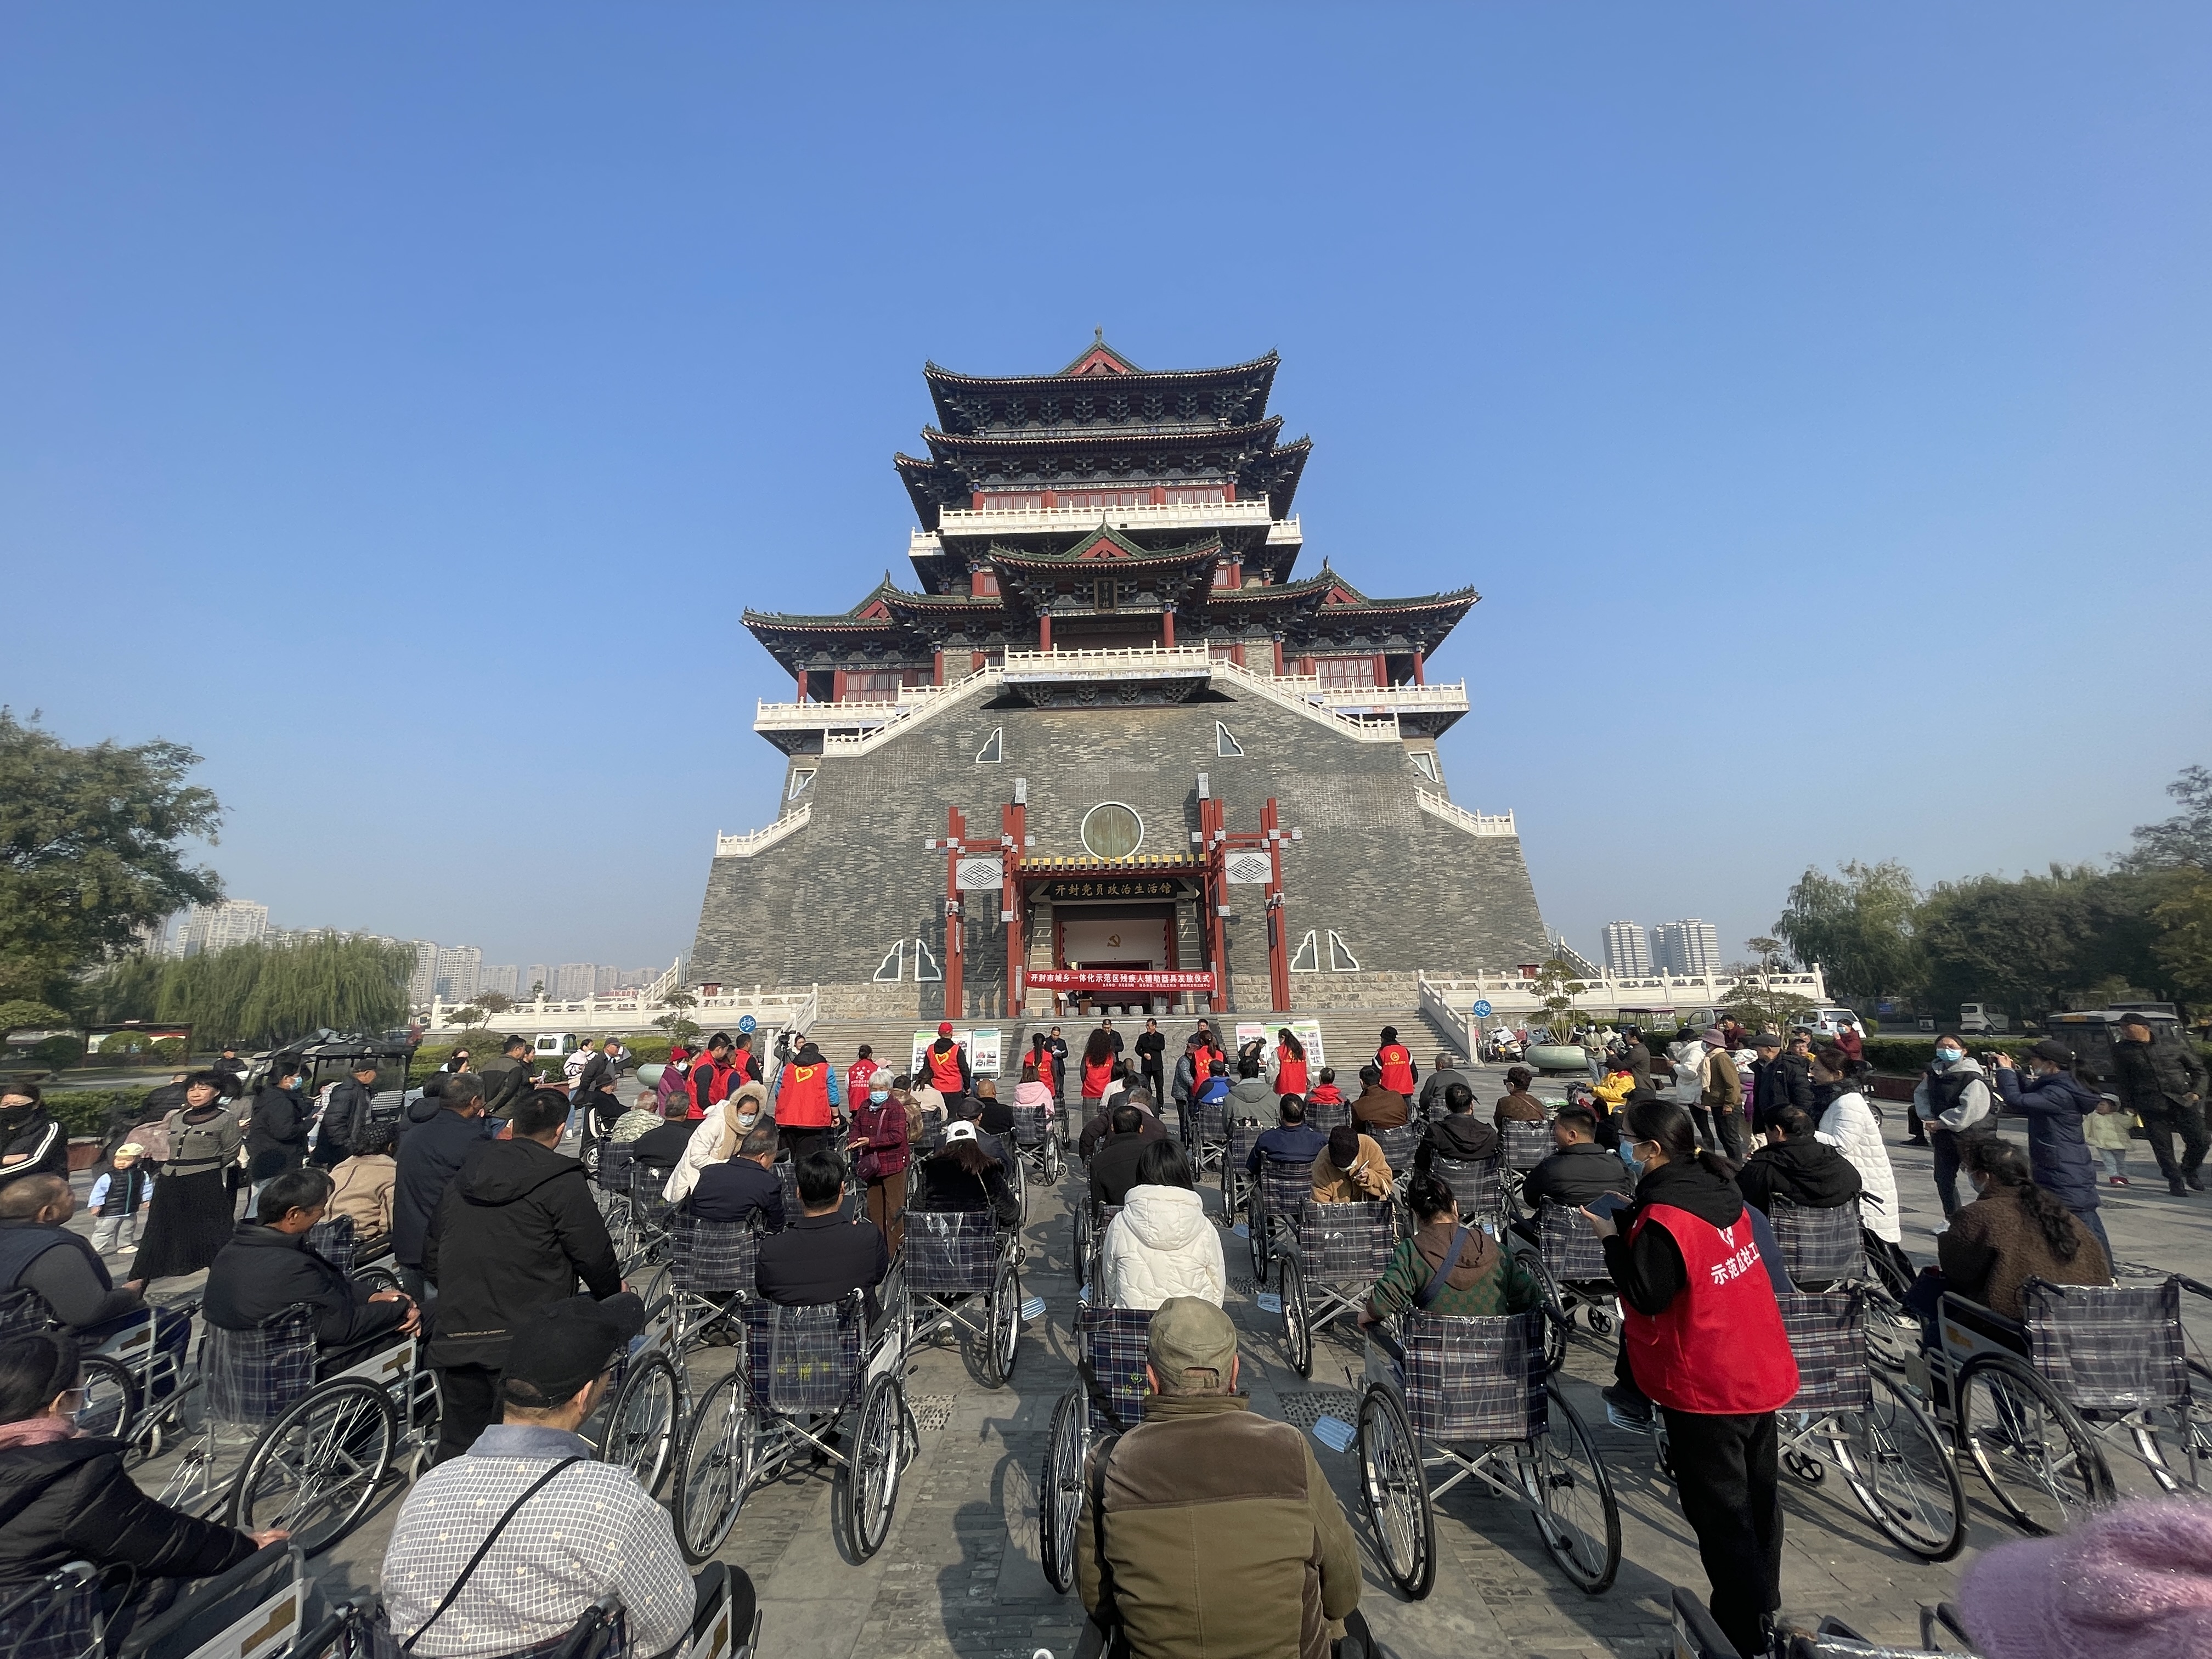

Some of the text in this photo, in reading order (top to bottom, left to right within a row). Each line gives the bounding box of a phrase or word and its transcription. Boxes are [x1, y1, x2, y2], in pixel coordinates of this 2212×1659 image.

[1055, 882, 1172, 896] 开封党员政治生活馆
[1030, 973, 1210, 983] 开封市城乡一体化示范区残疾人辅助器具发放仪式
